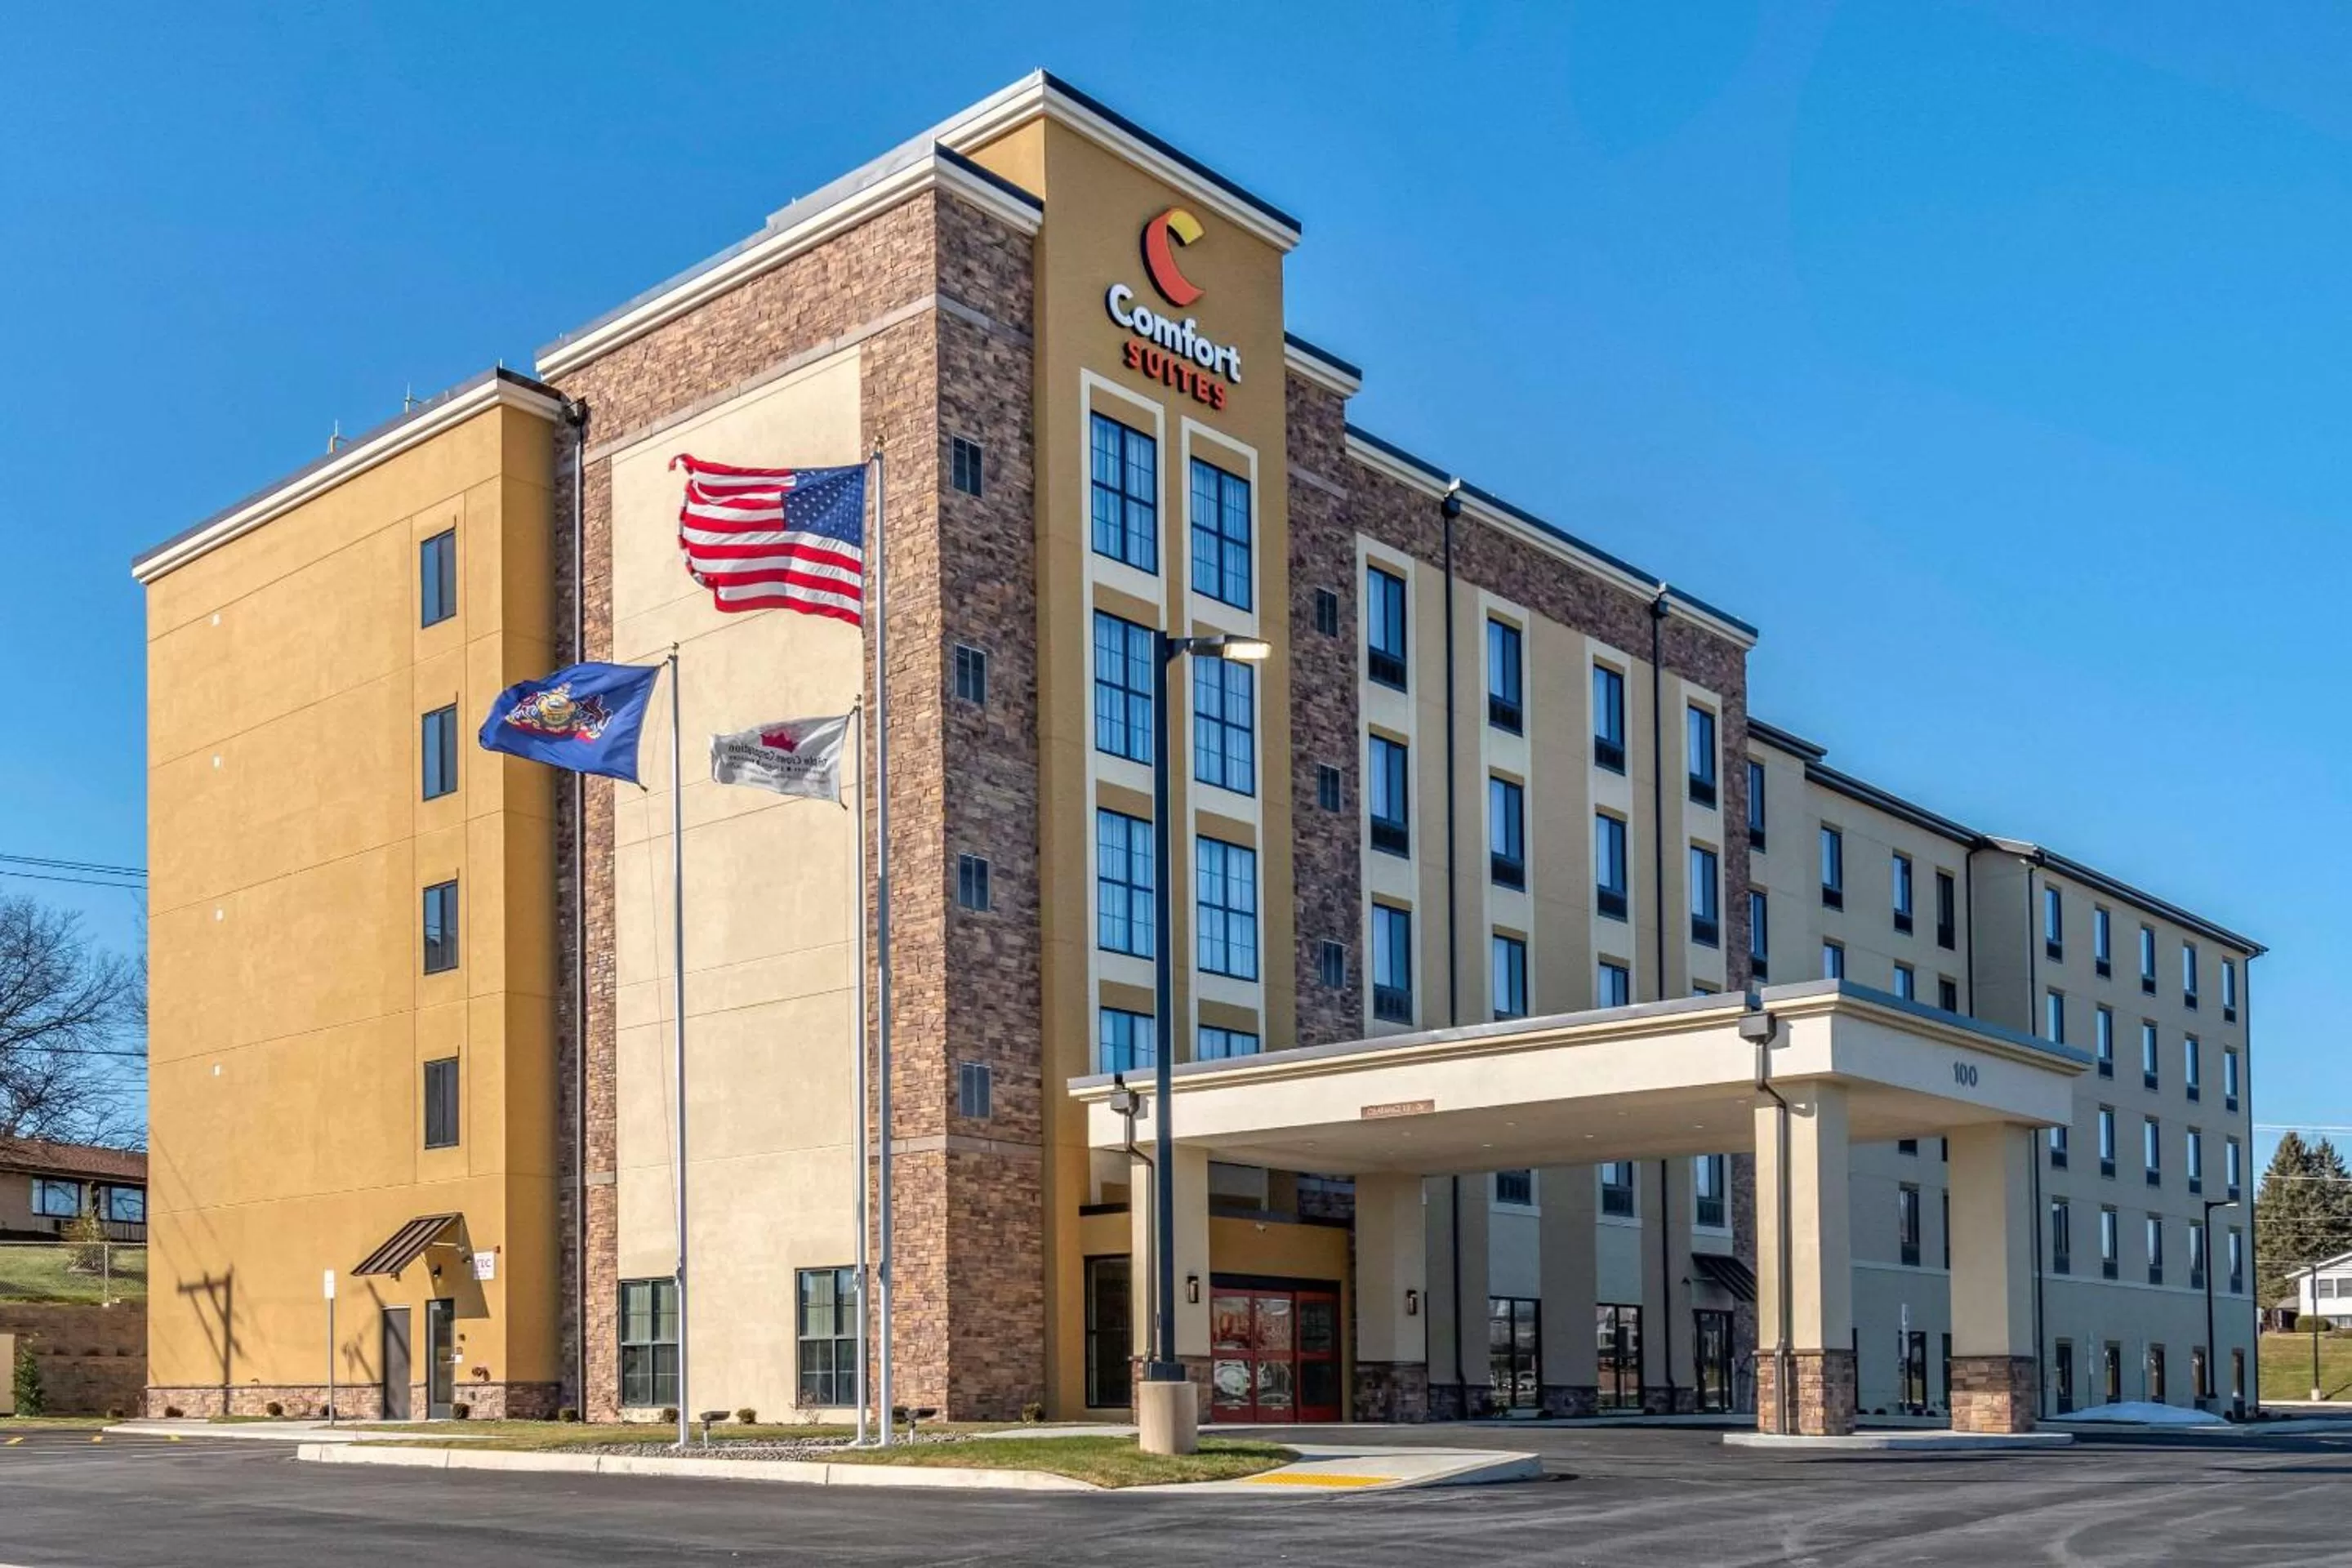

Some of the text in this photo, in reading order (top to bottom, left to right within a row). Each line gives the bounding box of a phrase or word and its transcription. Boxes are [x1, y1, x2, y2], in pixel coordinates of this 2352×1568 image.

[1106, 283, 1241, 384] Comfort
[1124, 338, 1228, 409] SUITES
[1953, 1061, 1978, 1088] 100
